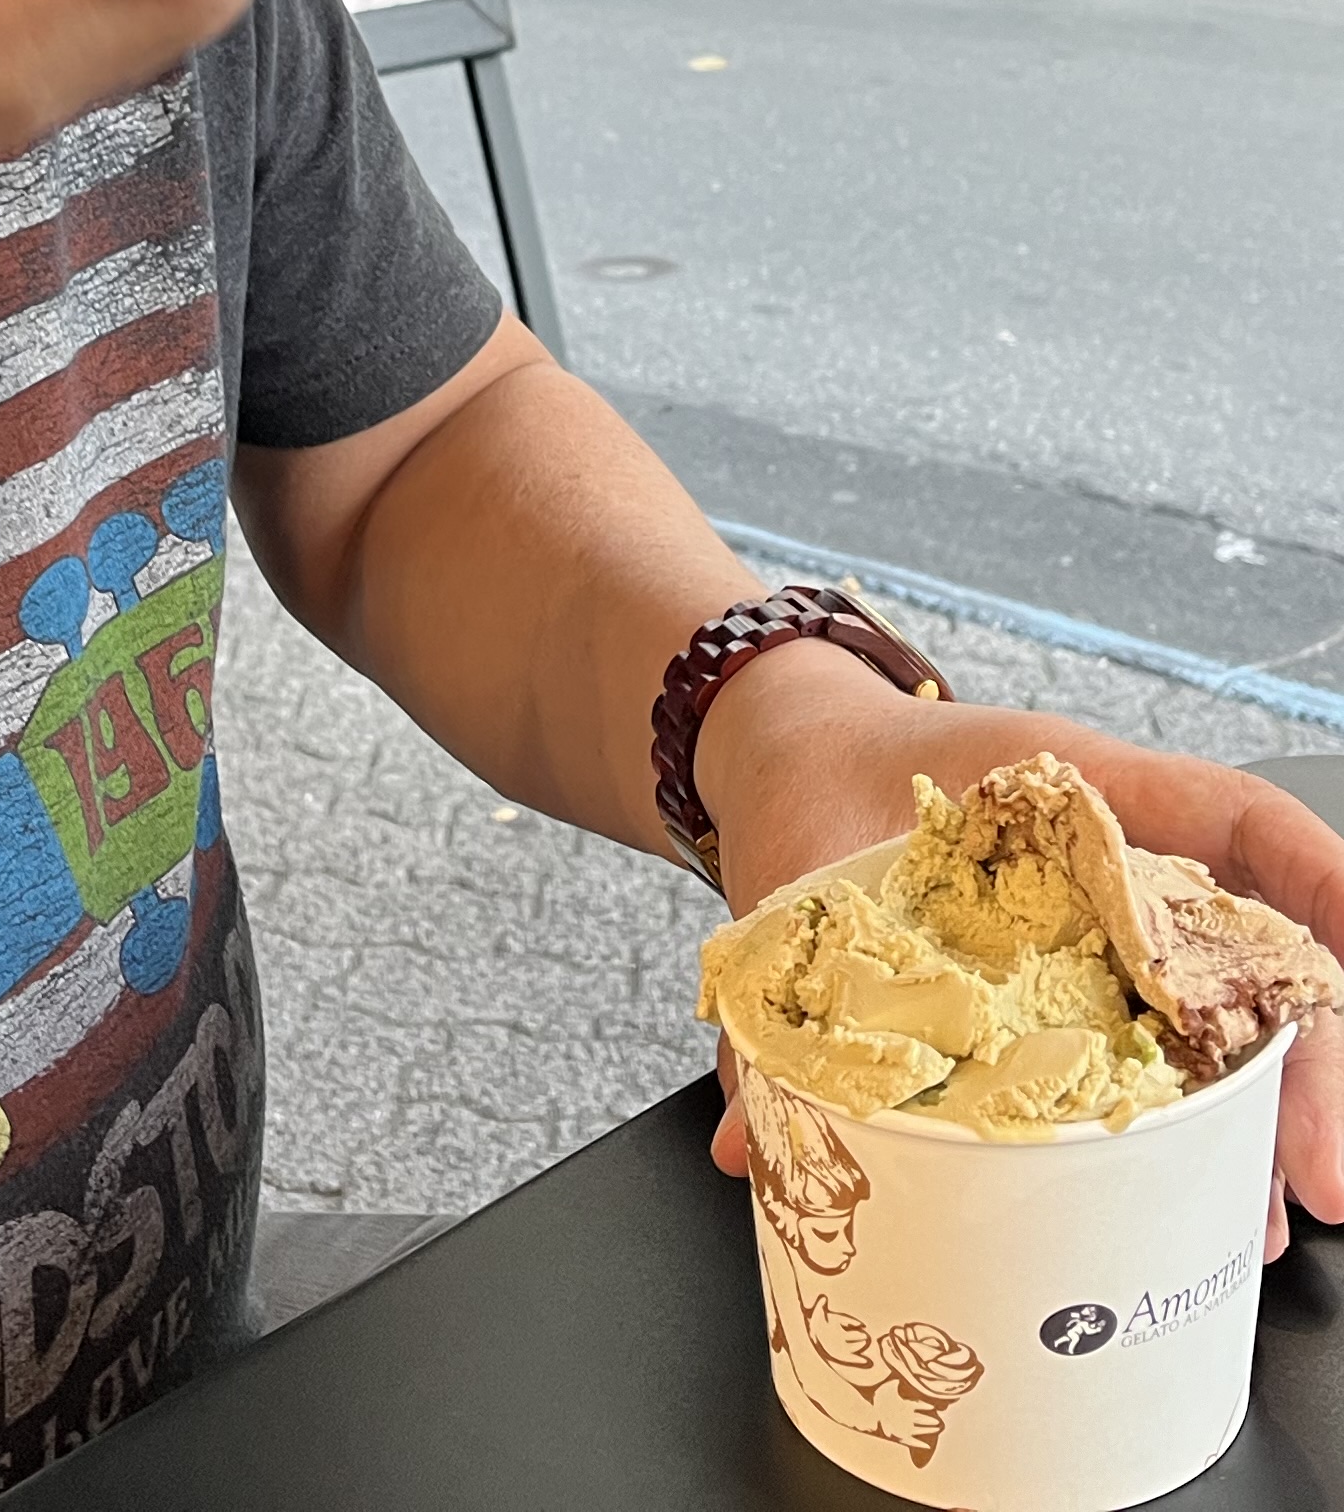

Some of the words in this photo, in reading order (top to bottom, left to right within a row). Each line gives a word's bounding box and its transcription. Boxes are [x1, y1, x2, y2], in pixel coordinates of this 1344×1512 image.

[1122, 1239, 1254, 1334] Amorino
[1120, 1319, 1180, 1349] GELATO
[1183, 1308, 1201, 1328] AL
